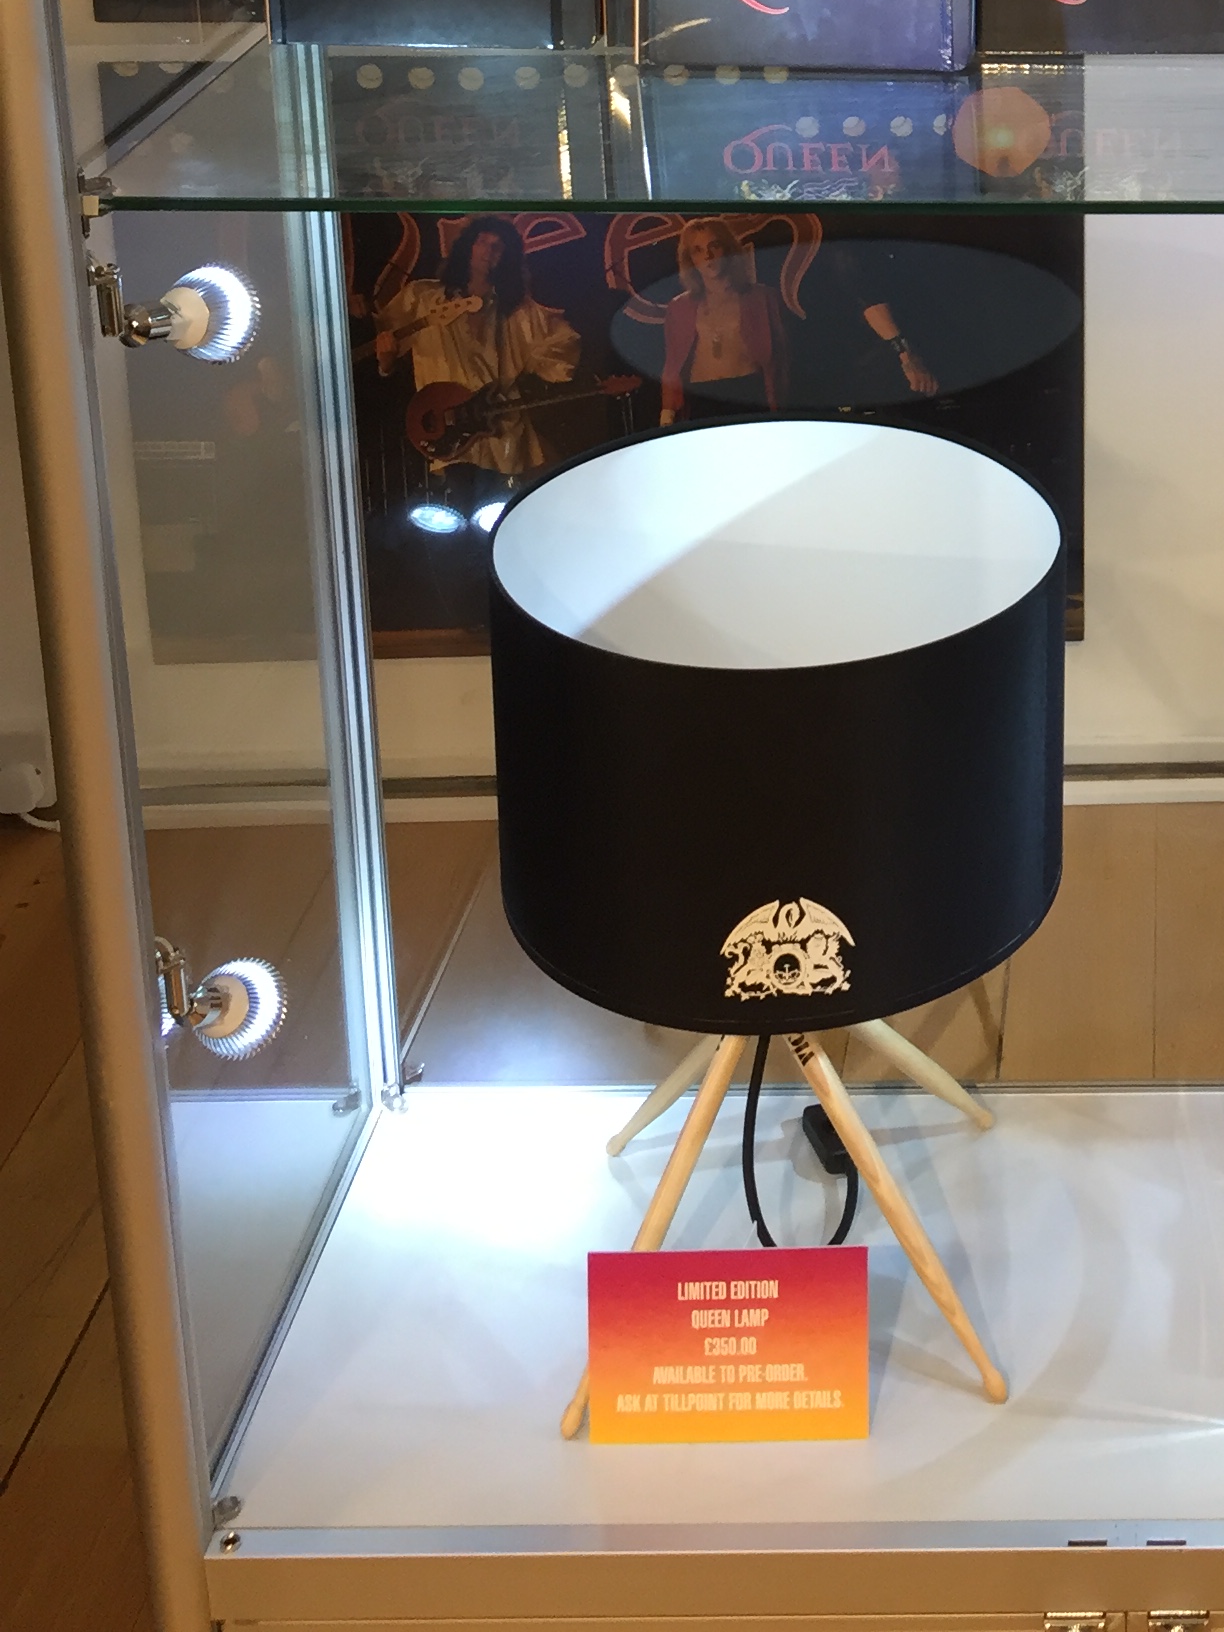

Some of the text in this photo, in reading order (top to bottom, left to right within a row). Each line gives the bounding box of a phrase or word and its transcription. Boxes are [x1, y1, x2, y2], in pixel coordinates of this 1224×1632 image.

[677, 1280, 779, 1301] LIMITED EDITION
[691, 1308, 769, 1329] QUEEN LAMP
[704, 1336, 757, 1356] £350.00
[653, 1363, 808, 1385] AVAILABLE TO PRE-ORDER.
[617, 1394, 641, 1413] ASK
[644, 1394, 660, 1412] AT
[663, 1393, 724, 1412] TILLPOINT
[728, 1392, 752, 1411] FOR
[755, 1391, 790, 1410] MORE
